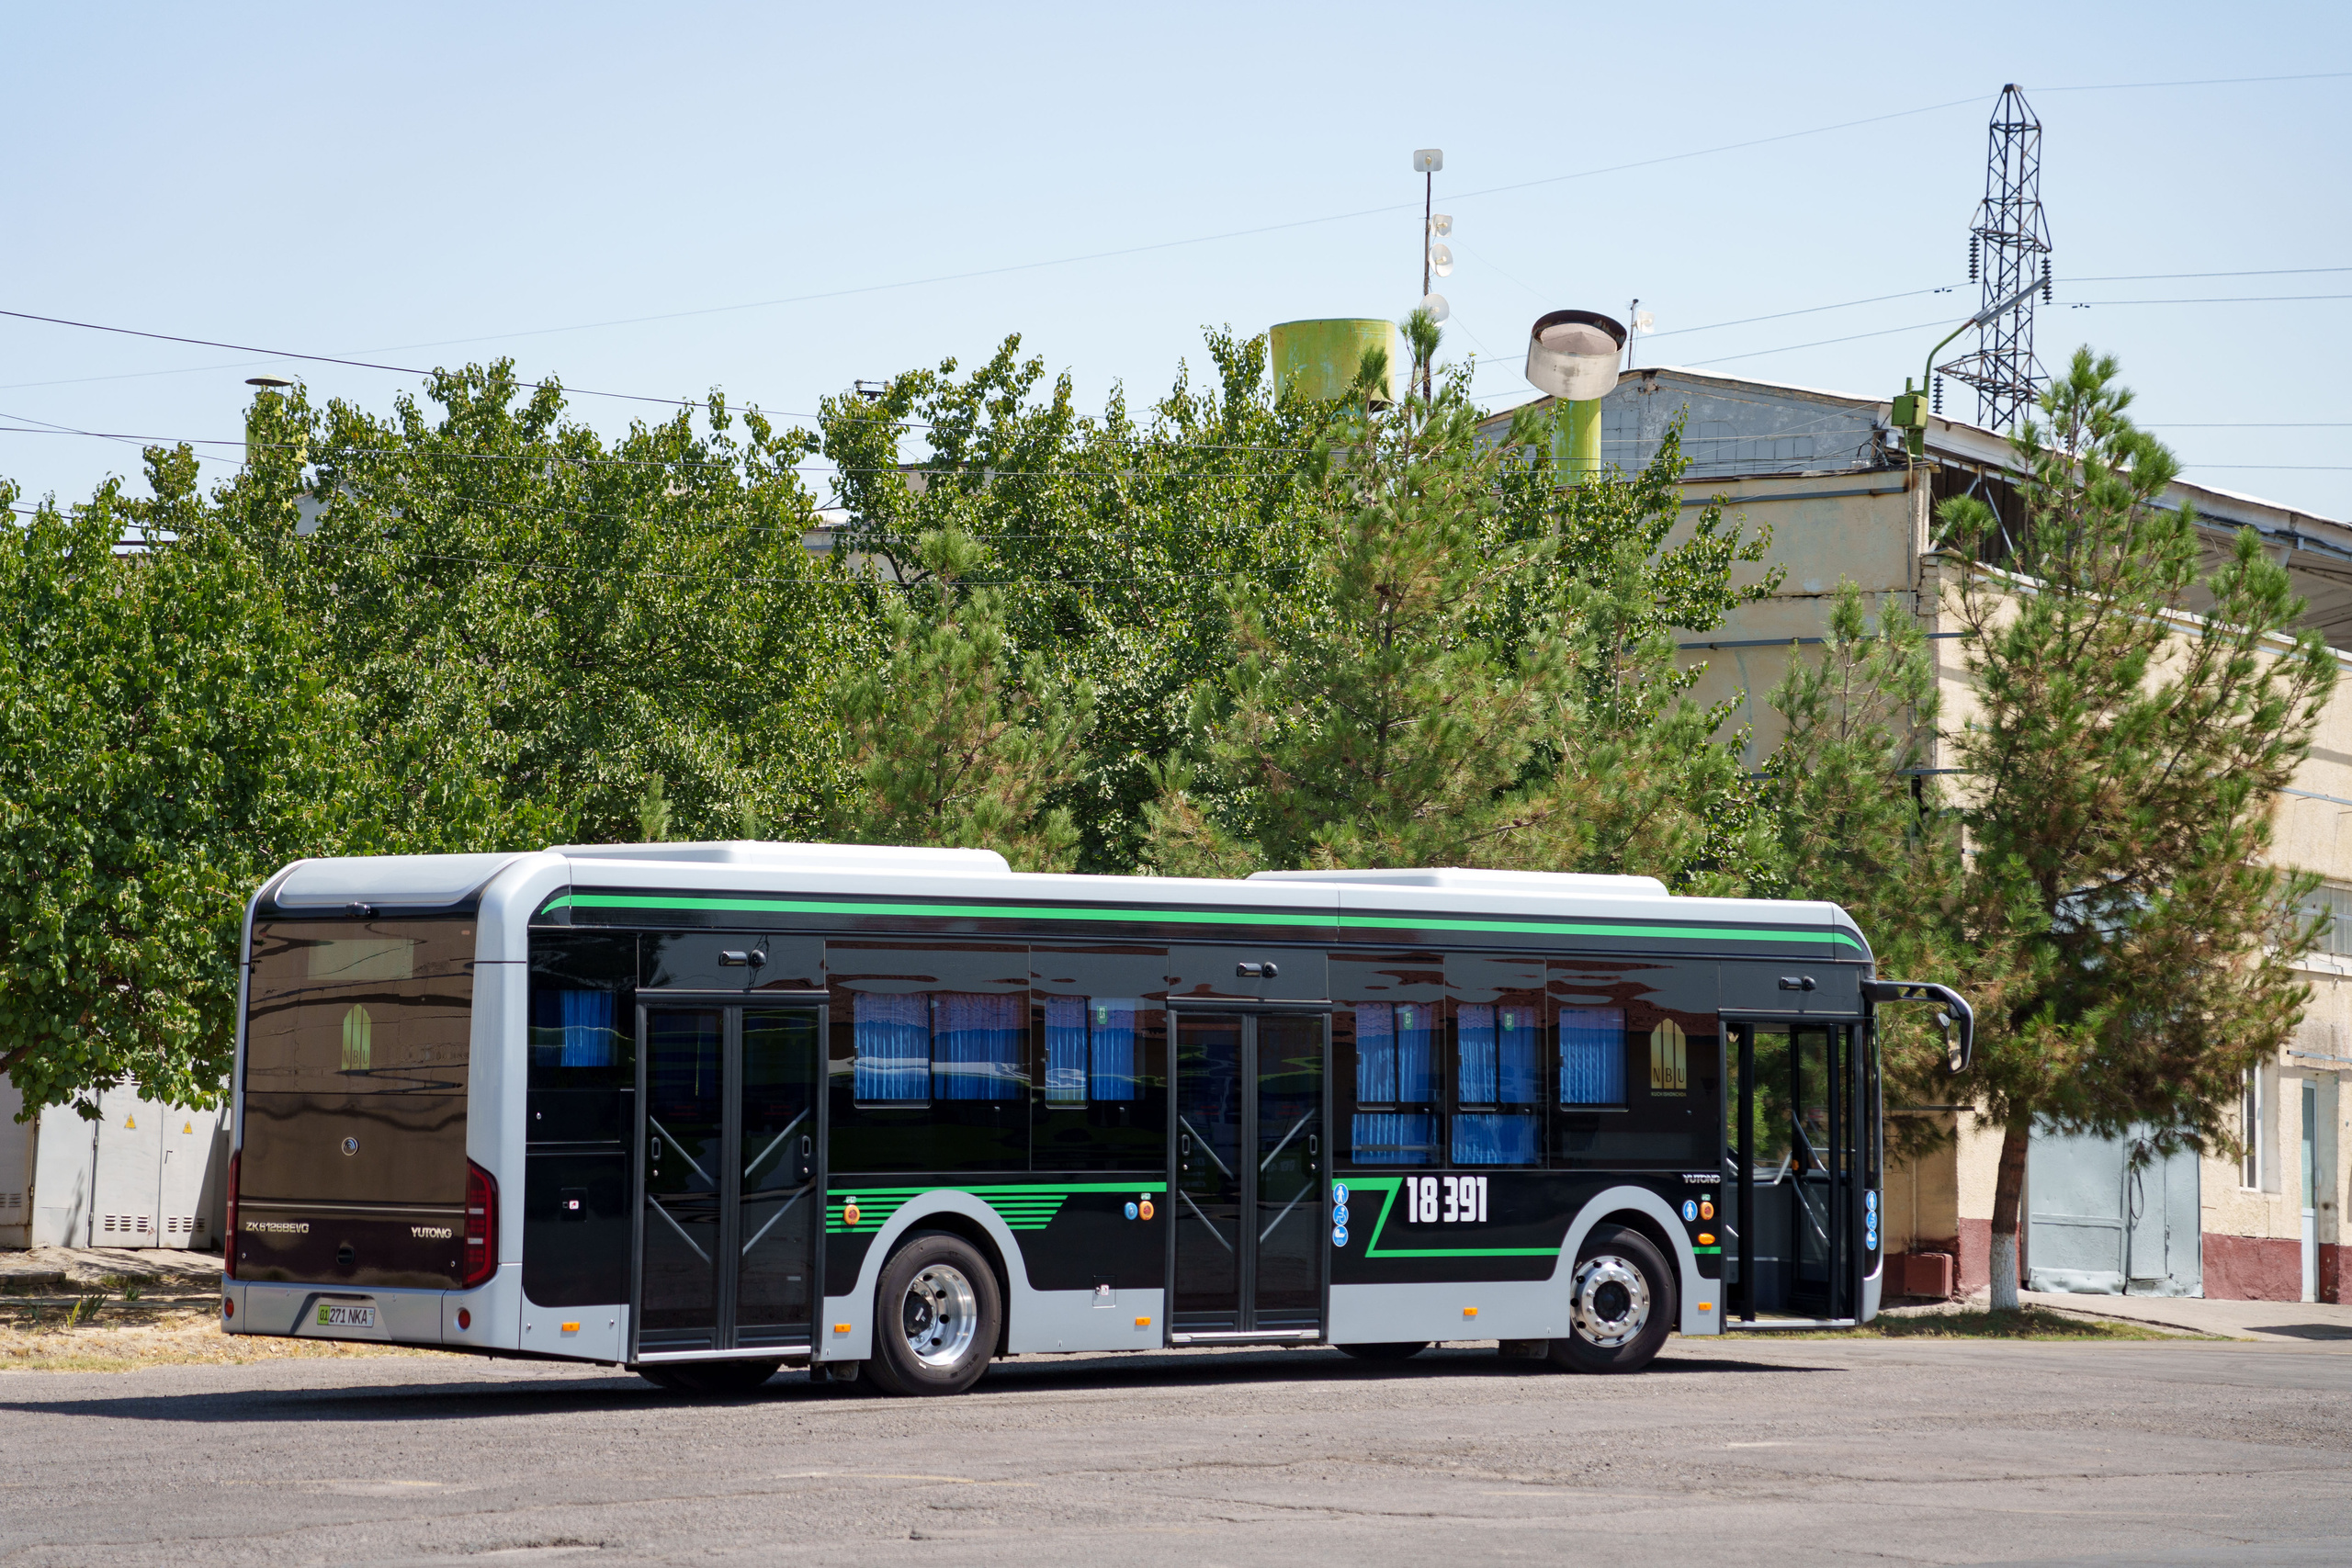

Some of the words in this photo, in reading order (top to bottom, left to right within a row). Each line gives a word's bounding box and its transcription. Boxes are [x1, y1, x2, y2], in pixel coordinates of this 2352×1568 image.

[1653, 1067, 1685, 1083] NBU
[1682, 1173, 1721, 1184] YUTONG
[245, 1222, 310, 1234] ZK6126BEVG
[411, 1226, 453, 1239] YUTONG
[319, 1309, 329, 1321] 01
[329, 1308, 345, 1323] 271
[347, 1308, 368, 1325] NKA
